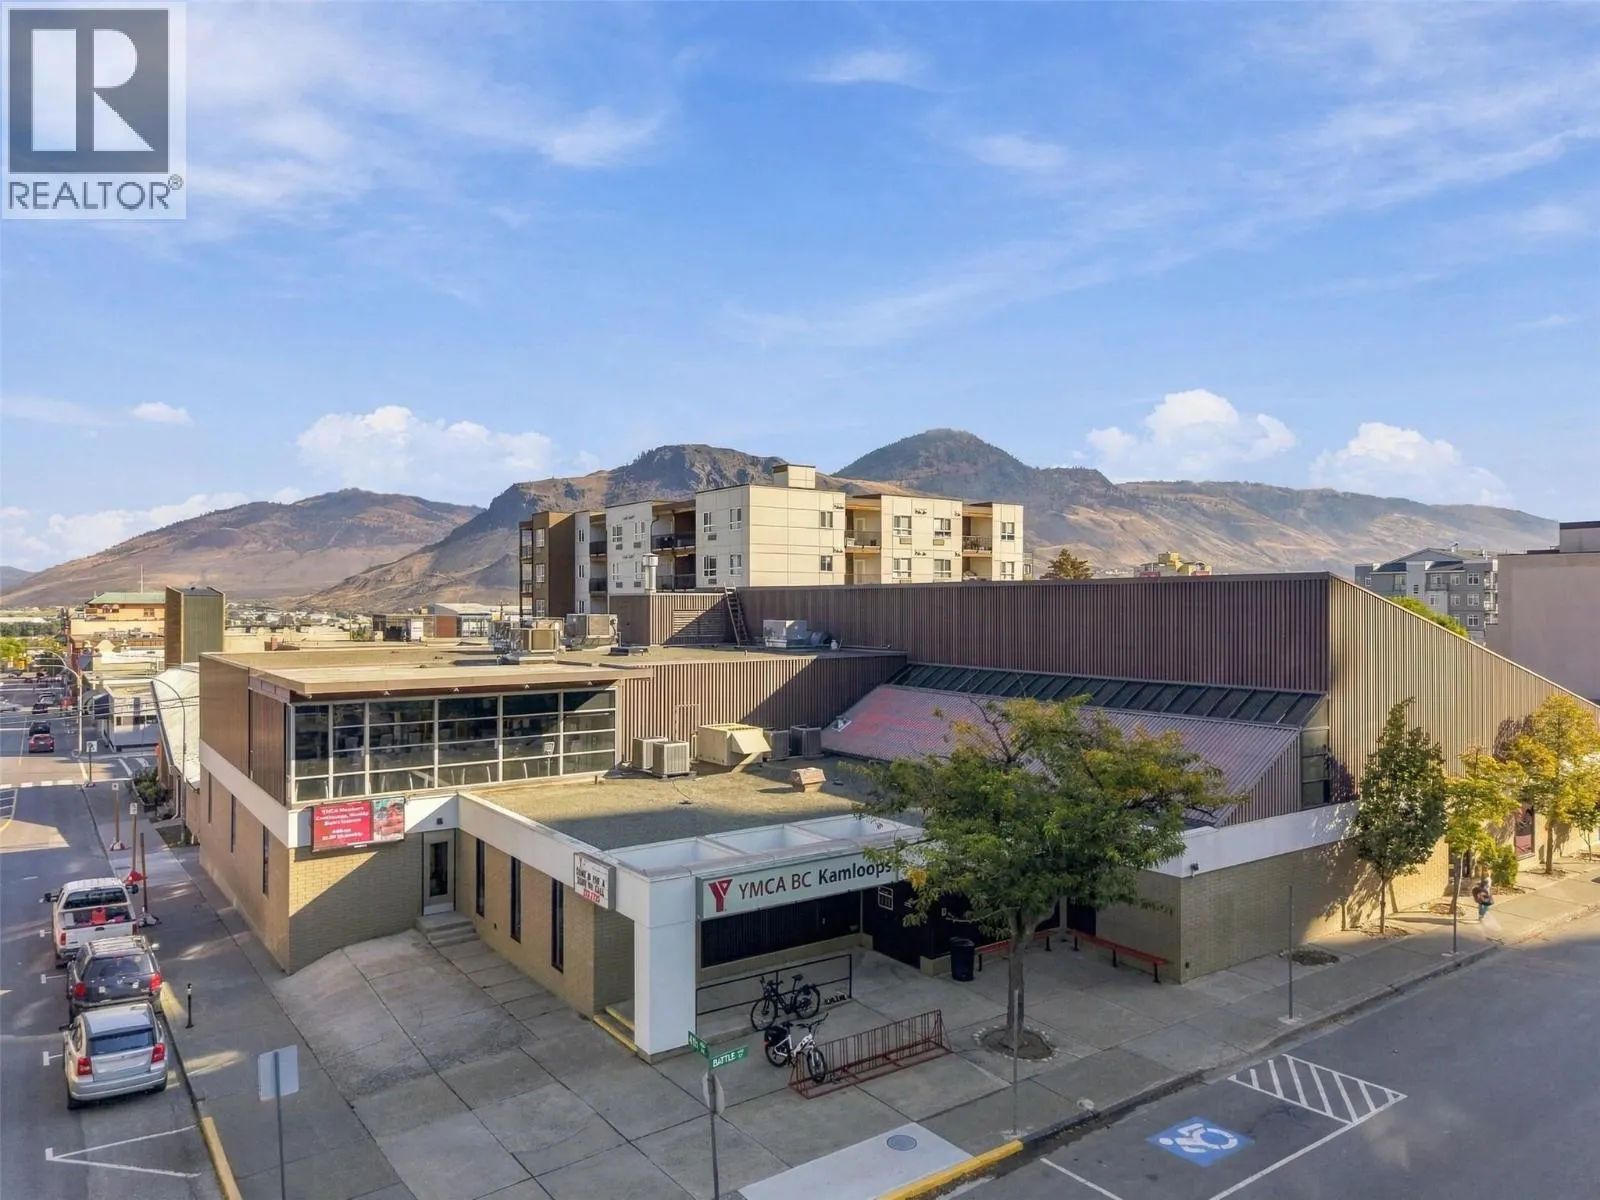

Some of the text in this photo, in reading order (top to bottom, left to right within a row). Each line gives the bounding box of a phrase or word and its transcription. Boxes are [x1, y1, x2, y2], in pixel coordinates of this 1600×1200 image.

[738, 876, 786, 900] YMCA
[791, 871, 812, 890] BC
[818, 862, 892, 886] Kamloops
[712, 1052, 736, 1067] BATTLE
